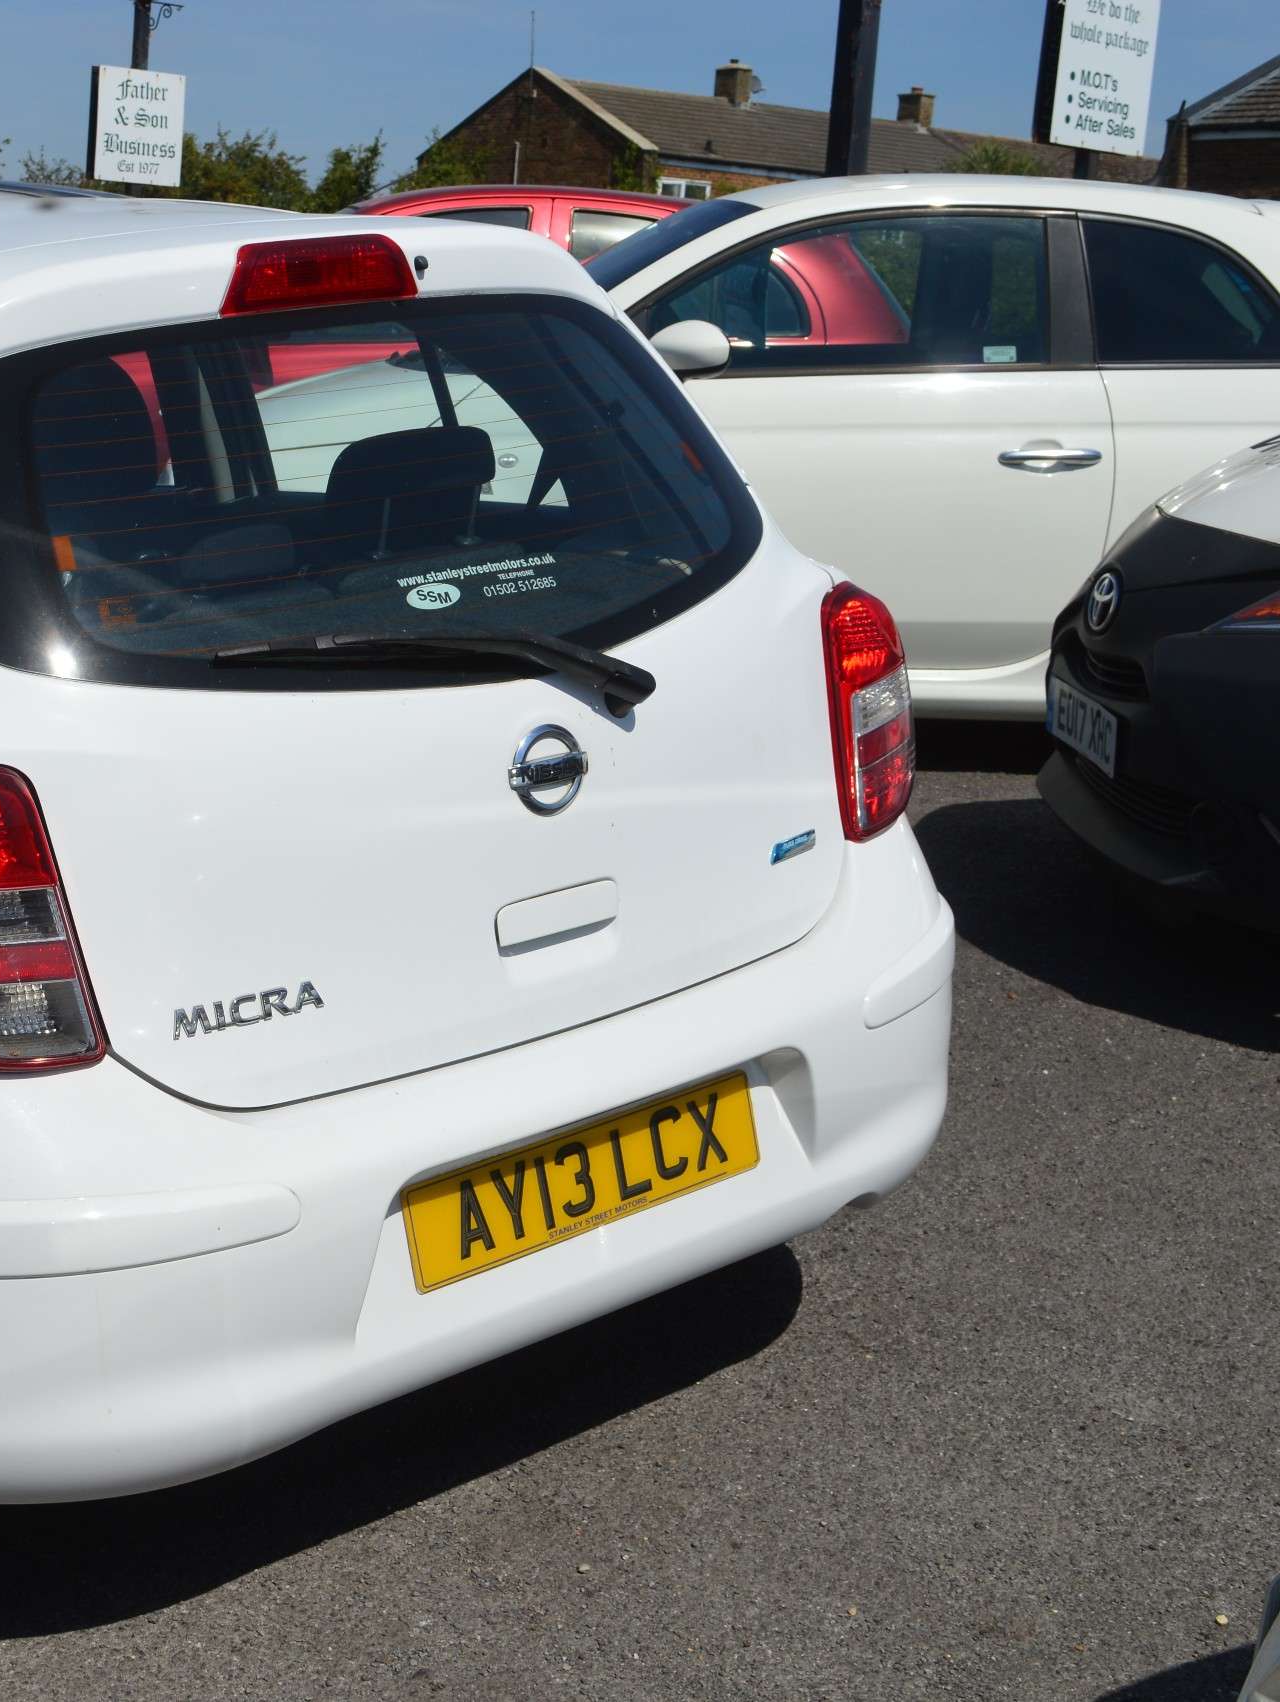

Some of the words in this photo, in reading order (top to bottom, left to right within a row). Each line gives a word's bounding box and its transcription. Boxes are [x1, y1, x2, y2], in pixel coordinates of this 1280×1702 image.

[1108, 0, 1121, 19] do
[1124, 4, 1141, 25] the
[1070, 22, 1103, 45] whole
[1105, 31, 1150, 57] package
[115, 79, 168, 102] Father
[114, 105, 129, 126] &
[134, 107, 168, 129] Son
[1078, 91, 1130, 120] Servicing
[1075, 114, 1103, 134] After
[1106, 119, 1136, 139] Sales
[104, 132, 176, 159] Business
[117, 159, 134, 173] Est
[138, 162, 160, 175] 1977
[397, 552, 557, 588] www.stanleystreetmotors.co.uk
[497, 568, 535, 581] TELEPHONE
[416, 588, 453, 605] SSM
[483, 581, 518, 598] 01502
[519, 576, 557, 592] 512685
[173, 980, 325, 1041] MICRA
[460, 1141, 596, 1260] AY13
[609, 1092, 728, 1202] LCX
[548, 1220, 584, 1240] STANLEY
[585, 1208, 613, 1225] STREET
[614, 1196, 648, 1213] MOTORS
